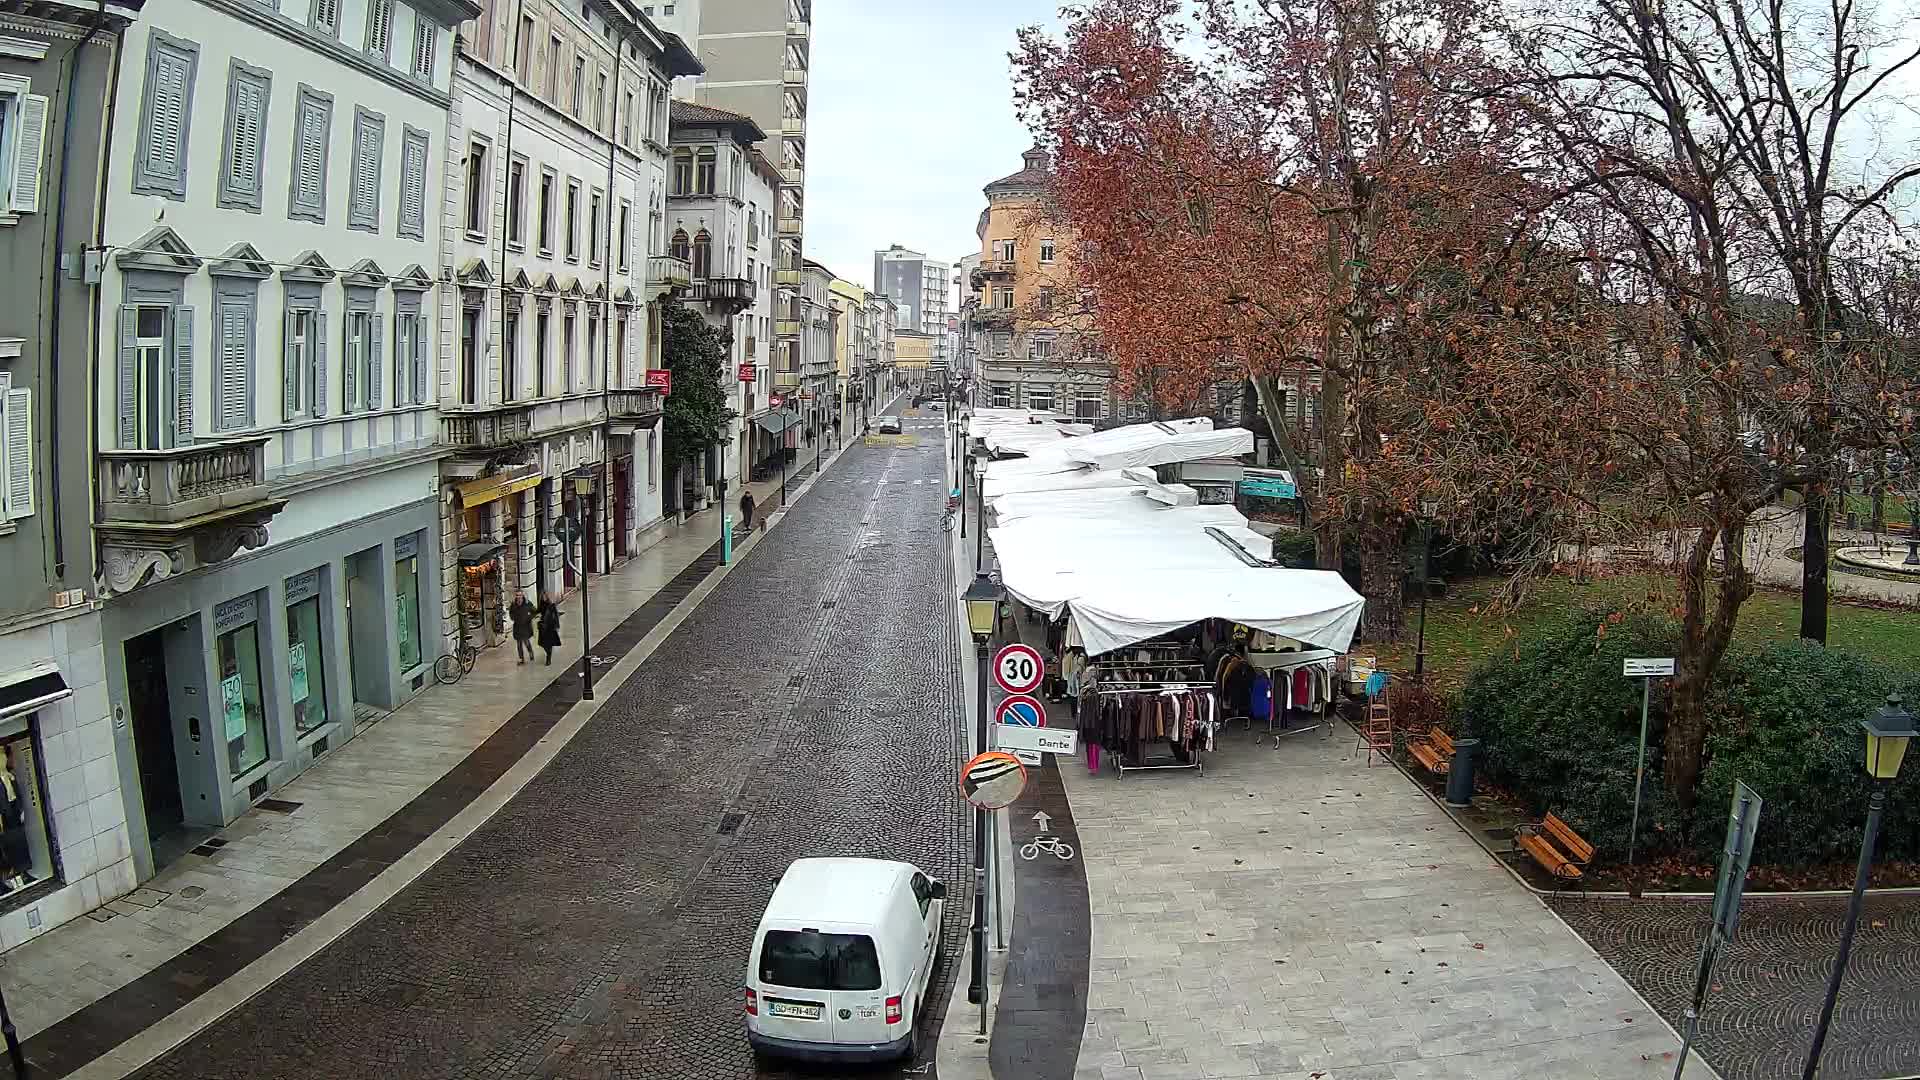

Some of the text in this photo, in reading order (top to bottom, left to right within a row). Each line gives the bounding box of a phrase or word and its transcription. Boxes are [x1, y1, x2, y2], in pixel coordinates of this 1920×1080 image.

[1006, 658, 1033, 680] 30
[222, 677, 241, 700] 130
[1038, 738, 1070, 749] Dante
